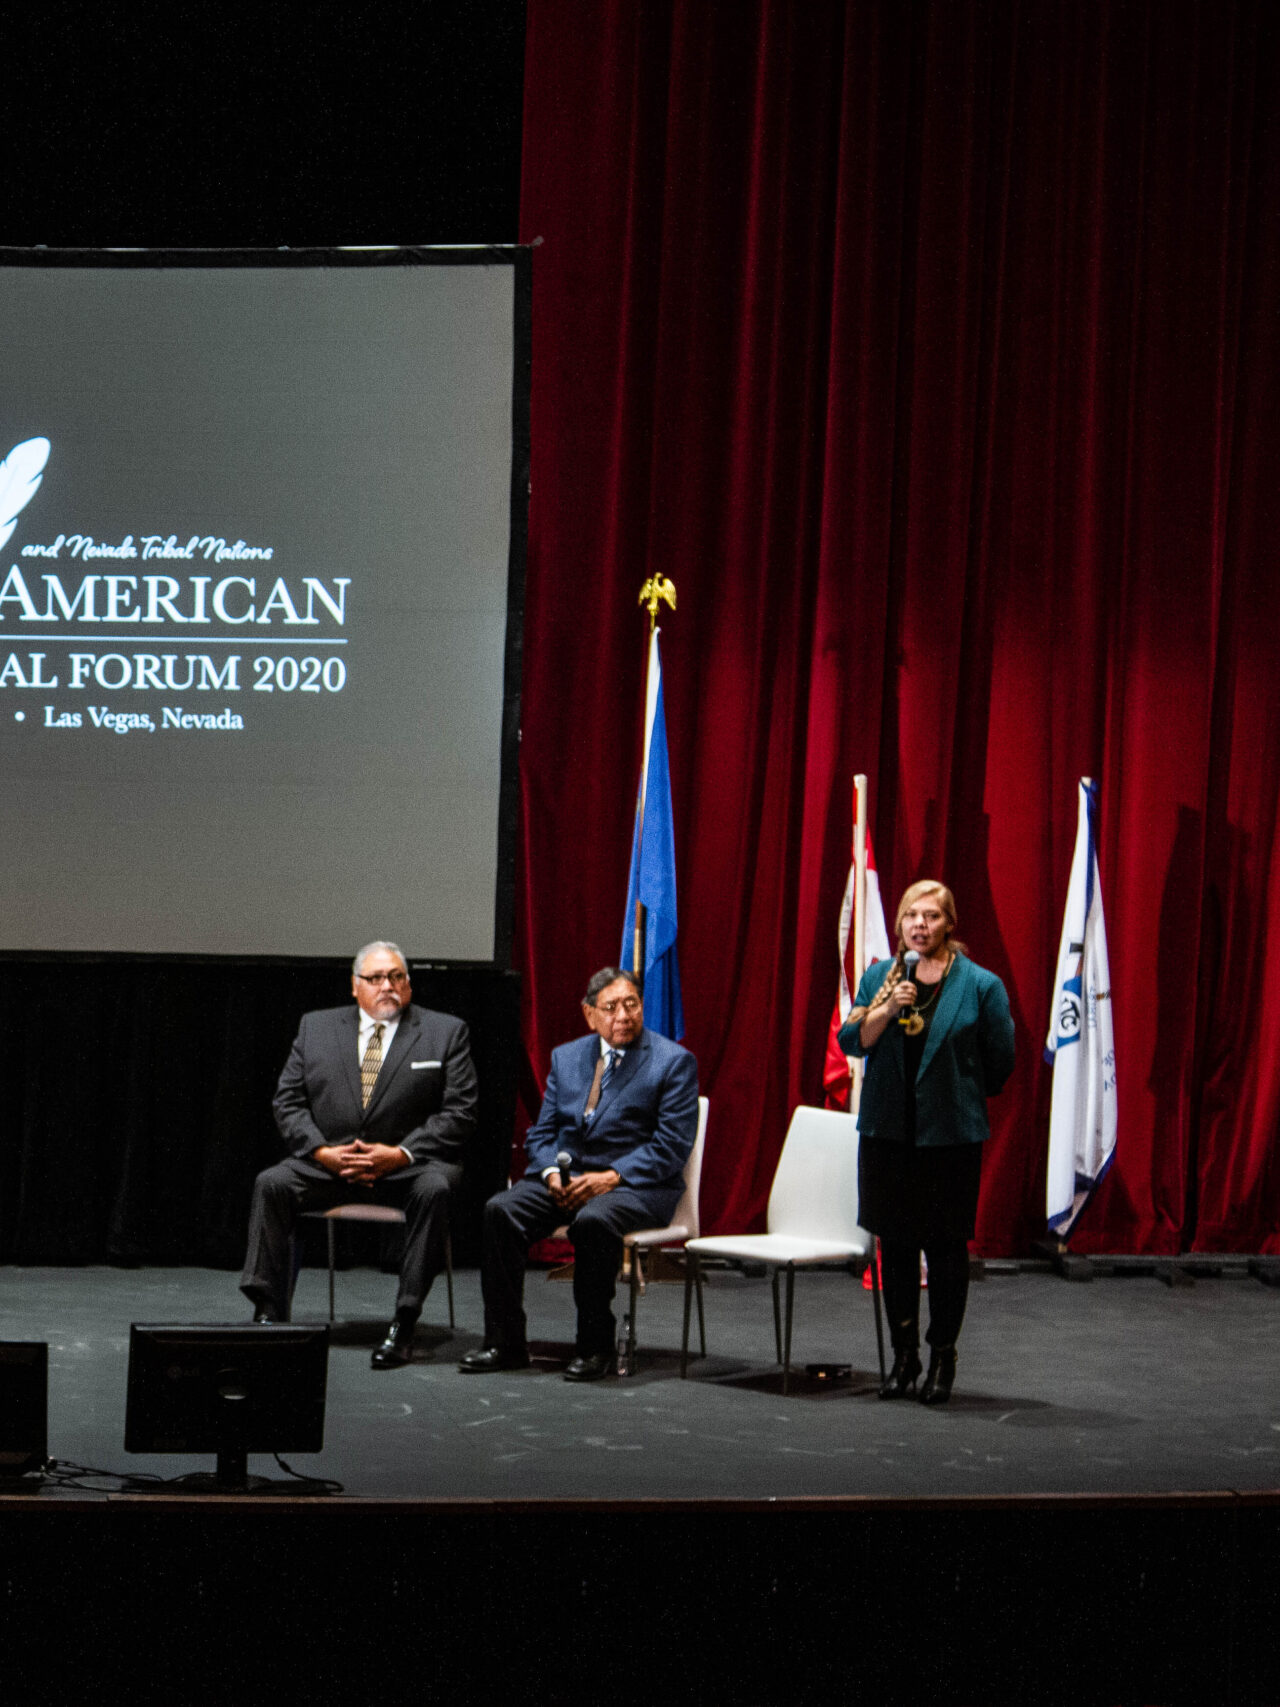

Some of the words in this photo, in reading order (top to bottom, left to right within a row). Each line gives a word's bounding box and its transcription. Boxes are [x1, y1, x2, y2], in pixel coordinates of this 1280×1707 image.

[21, 534, 65, 559] and
[65, 534, 138, 561] Nevada
[140, 535, 200, 561] Tribal
[198, 536, 274, 563] Nations
[68, 653, 242, 691] FORUM
[252, 656, 348, 693] 2020
[43, 705, 83, 728] Las
[87, 706, 156, 734] Vegas,
[161, 707, 245, 731] Nevada
